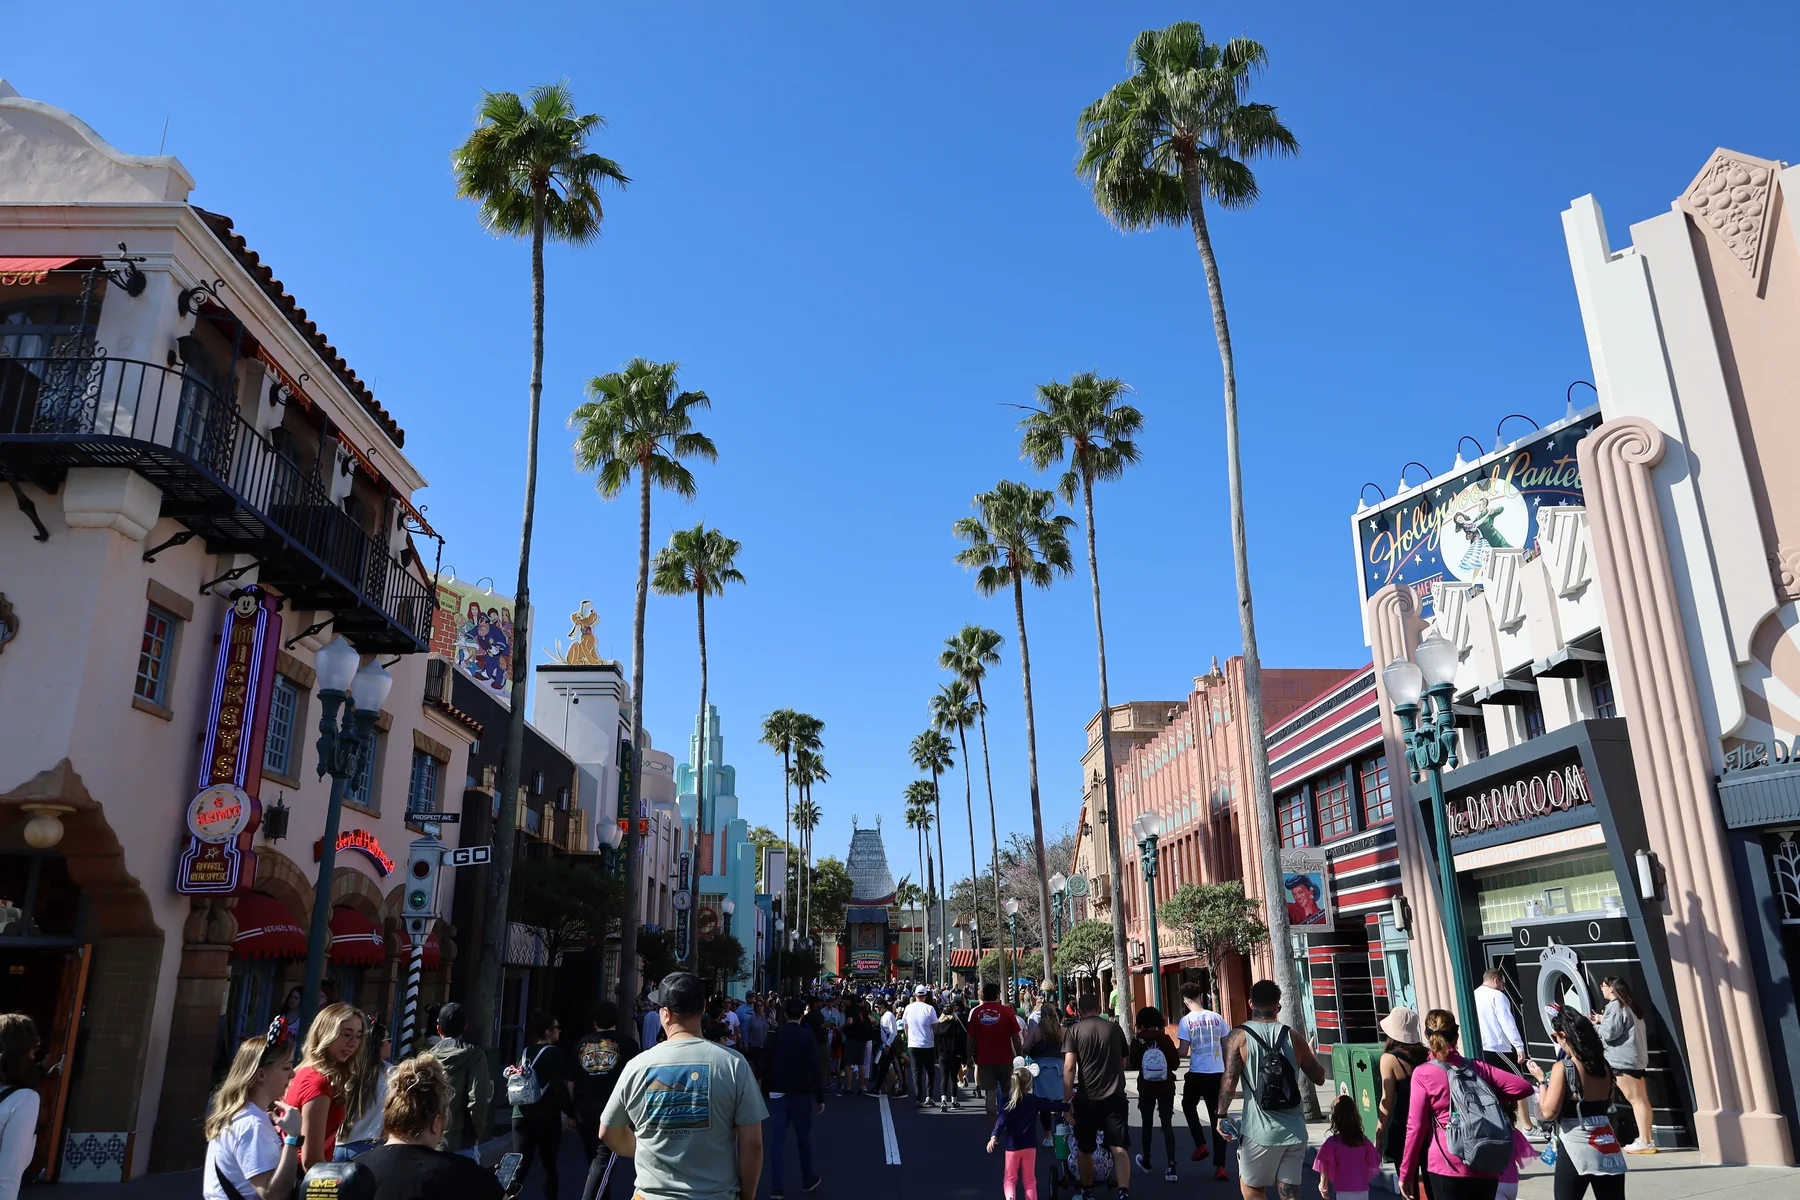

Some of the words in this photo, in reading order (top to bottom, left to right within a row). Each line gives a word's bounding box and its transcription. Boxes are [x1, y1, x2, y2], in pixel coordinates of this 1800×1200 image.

[1369, 464, 1500, 584] Hollywood
[1504, 452, 1582, 500] Cantee
[1466, 764, 1591, 830] DARKROOM
[453, 847, 488, 864] GO
[309, 1179, 338, 1188] GMS
